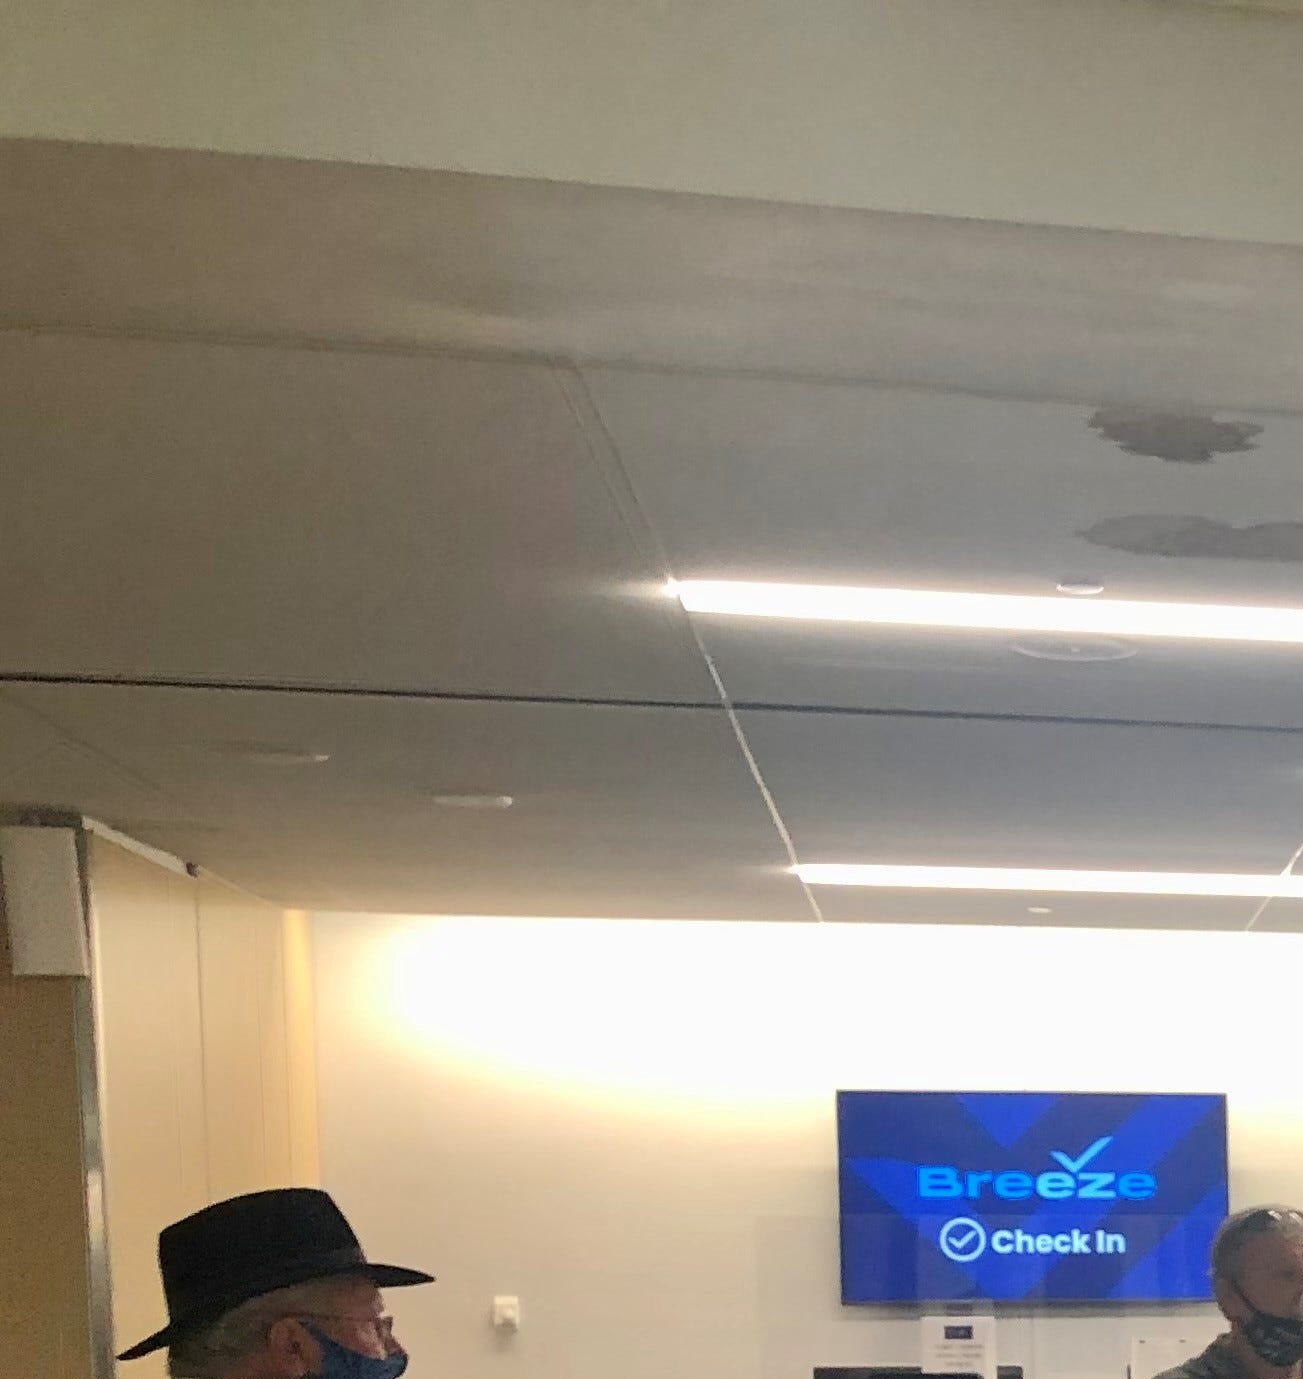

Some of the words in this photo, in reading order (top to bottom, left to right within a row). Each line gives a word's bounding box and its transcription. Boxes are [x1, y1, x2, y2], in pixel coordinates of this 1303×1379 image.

[917, 1165, 1157, 1200] Breeze
[991, 1228, 1091, 1254] Check
[1095, 1228, 1126, 1254] In
